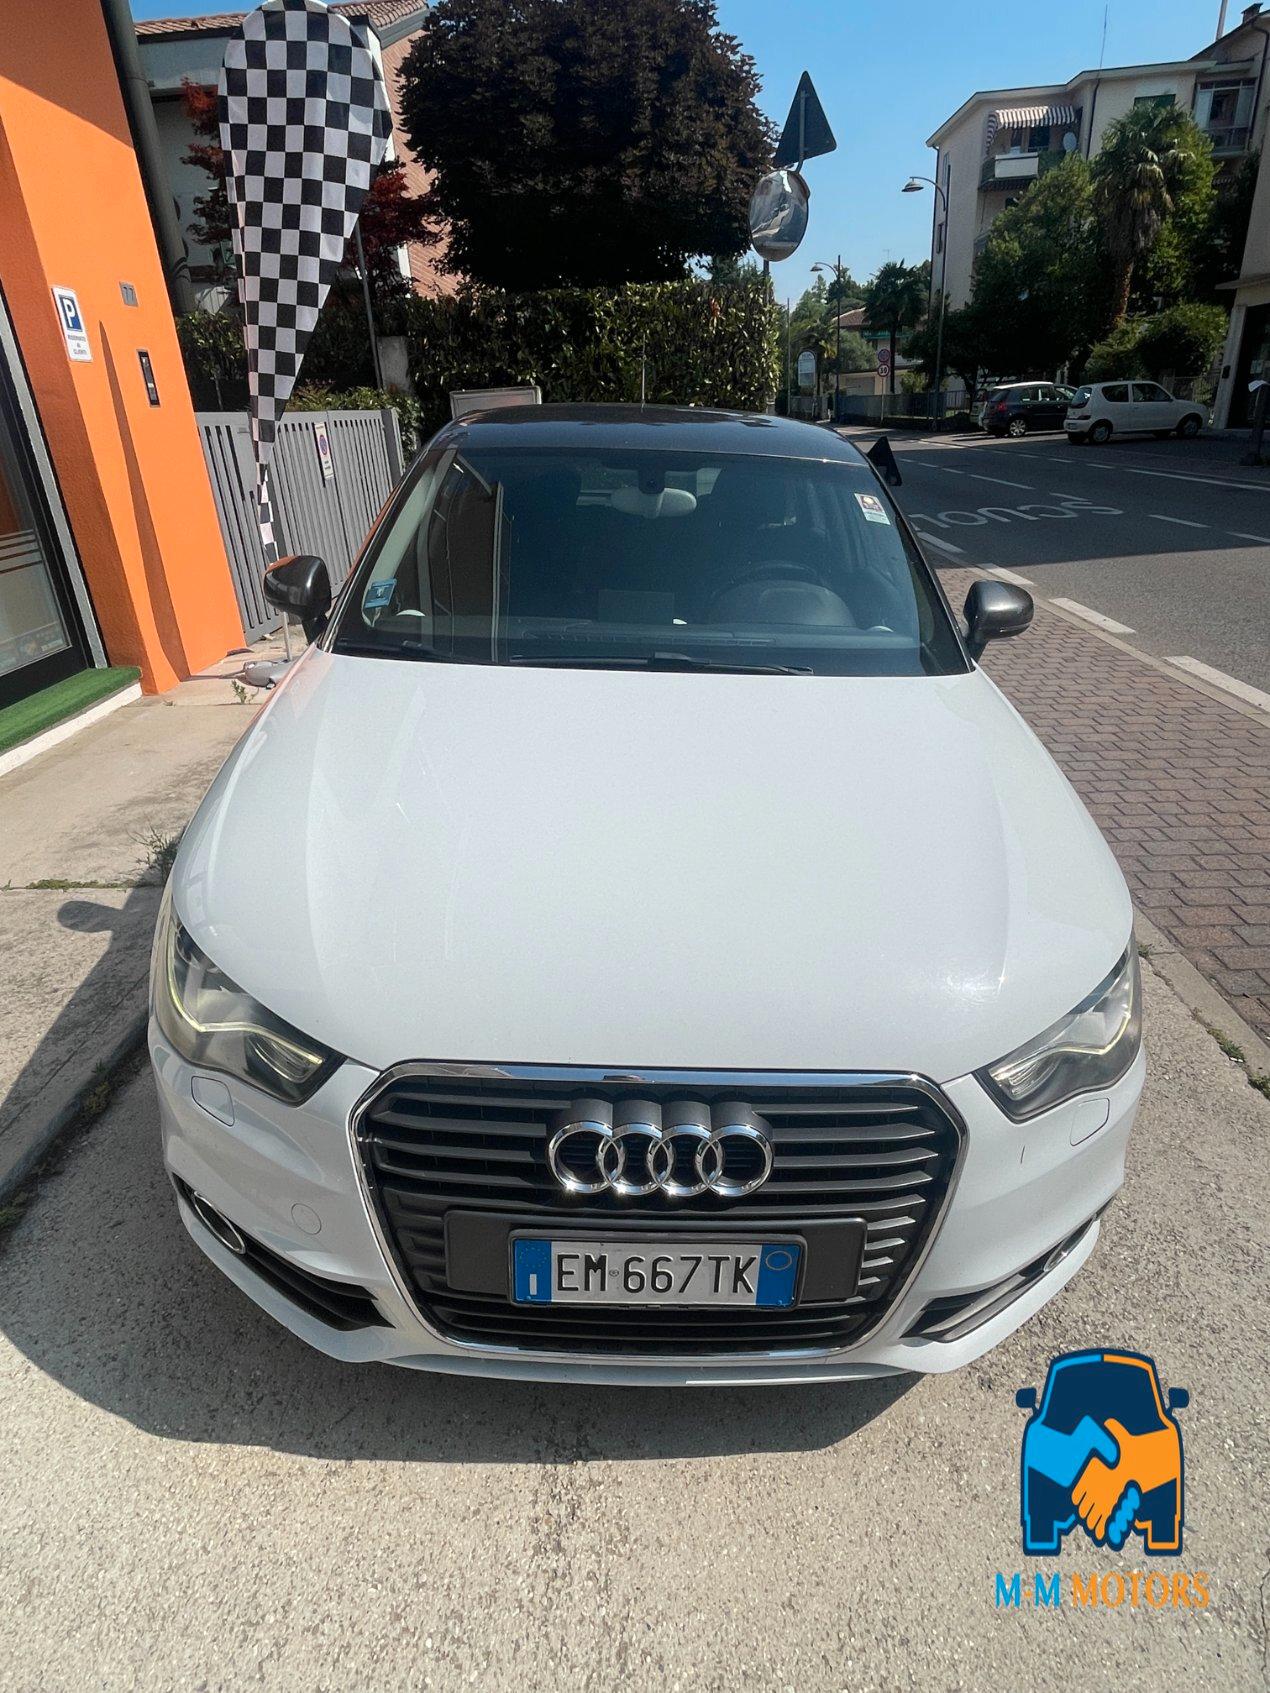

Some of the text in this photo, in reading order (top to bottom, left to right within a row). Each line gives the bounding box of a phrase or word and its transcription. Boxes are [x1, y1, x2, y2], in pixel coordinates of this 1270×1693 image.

[63, 299, 76, 327] P
[908, 500, 1124, 531] SCUOL
[556, 1253, 758, 1295] EM 667TK
